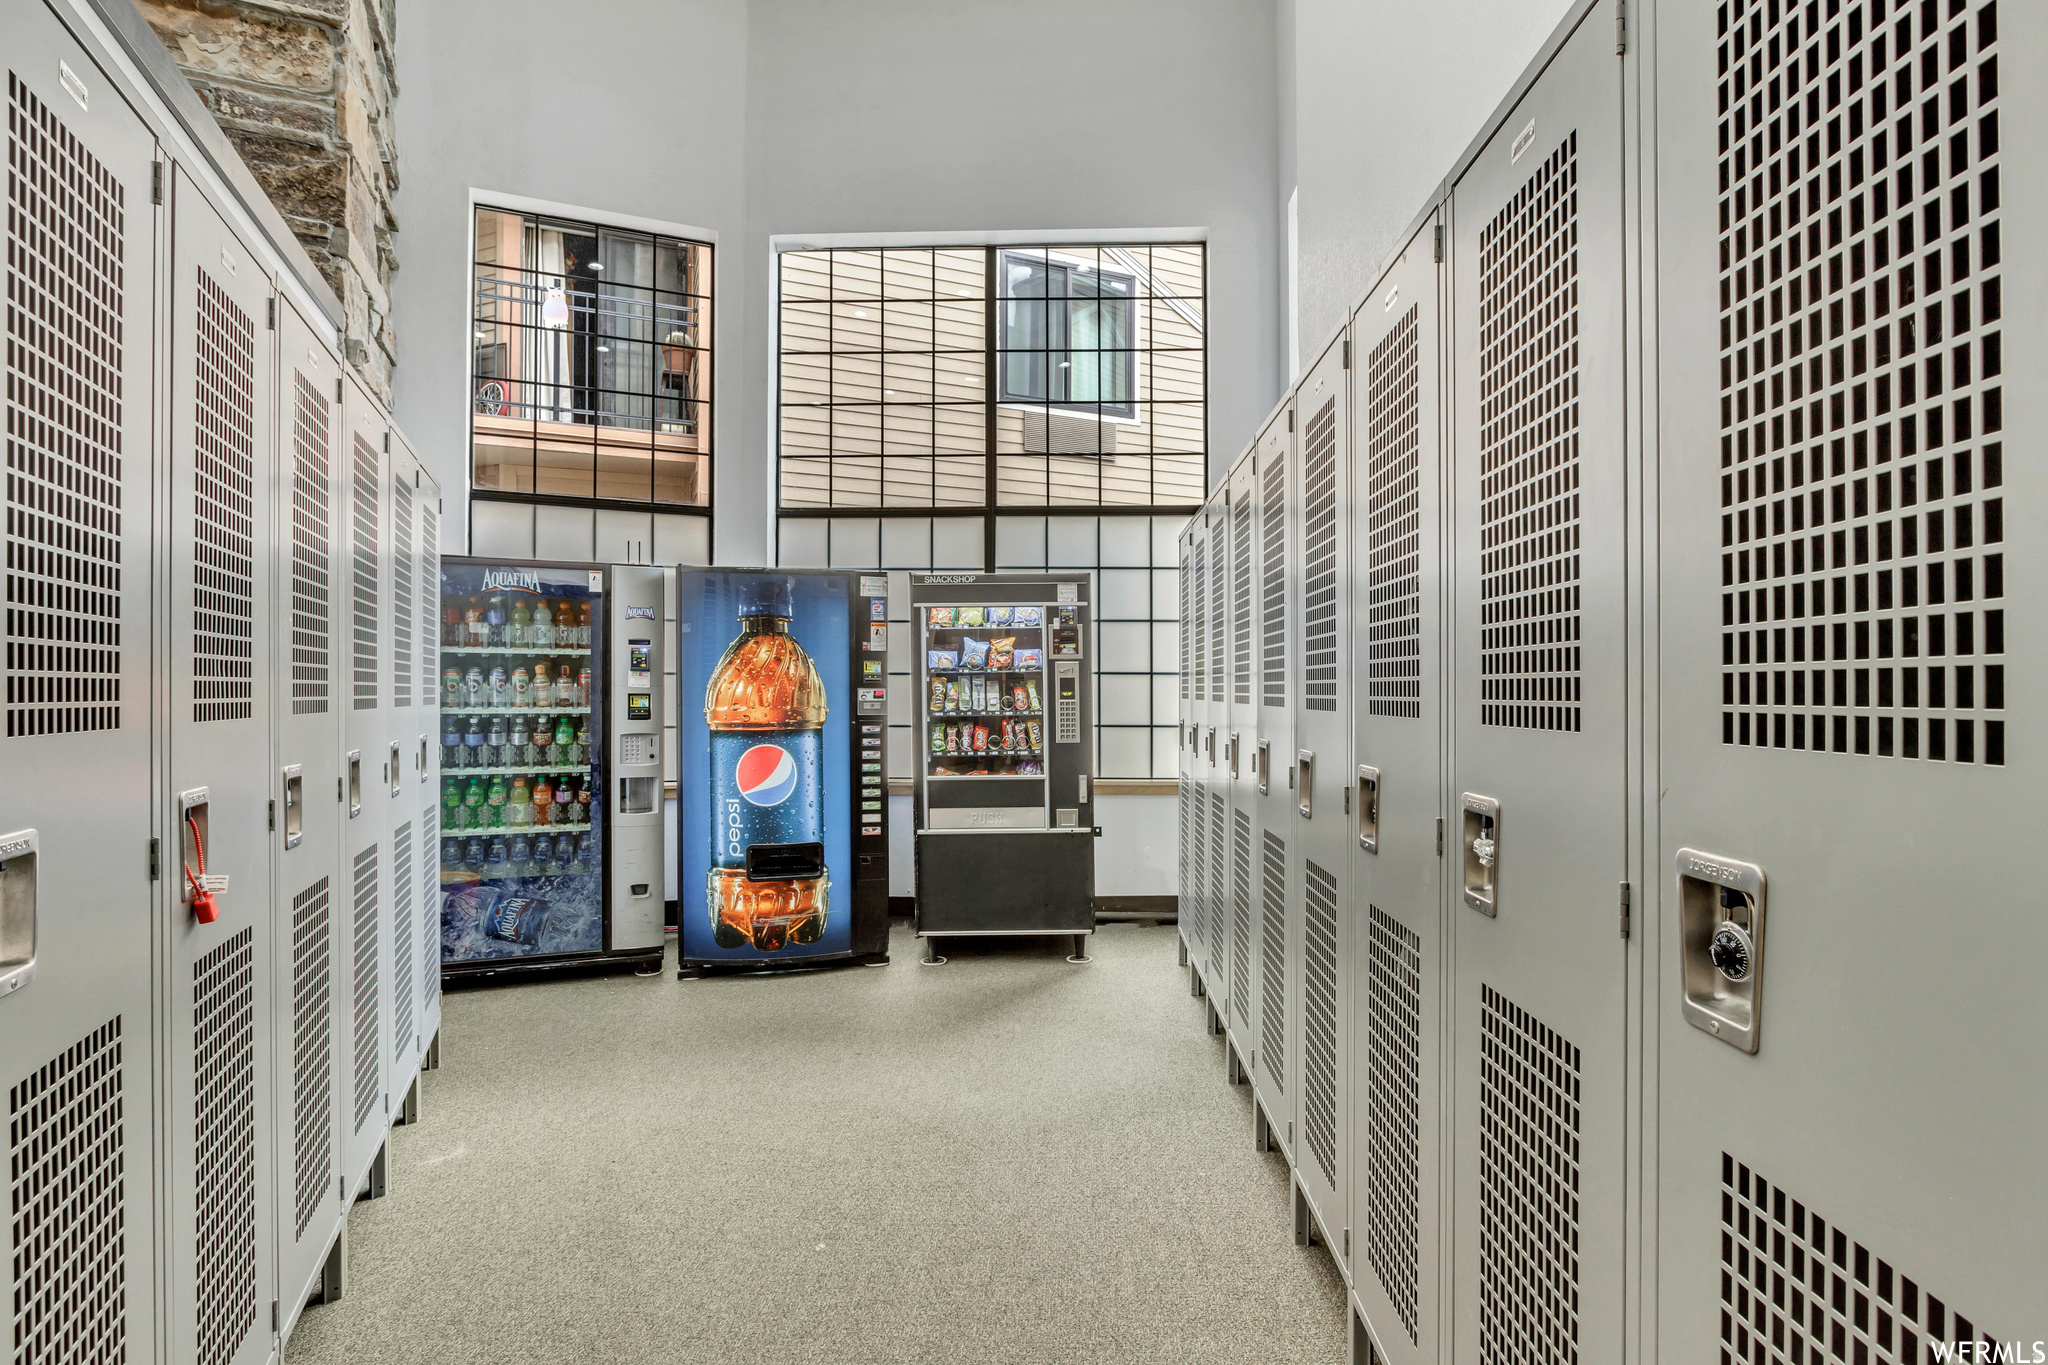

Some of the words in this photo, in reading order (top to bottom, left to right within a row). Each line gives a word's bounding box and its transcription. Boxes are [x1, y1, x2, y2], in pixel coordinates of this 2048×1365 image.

[481, 568, 542, 593] AQUAFINA
[924, 575, 976, 584] SNACKSHOP
[626, 605, 655, 619] AQUAFINA
[726, 799, 744, 857] pepsi
[971, 812, 1003, 825] PUSH
[1689, 858, 1741, 882] JORGENSON
[498, 897, 531, 940] AQUAFINA
